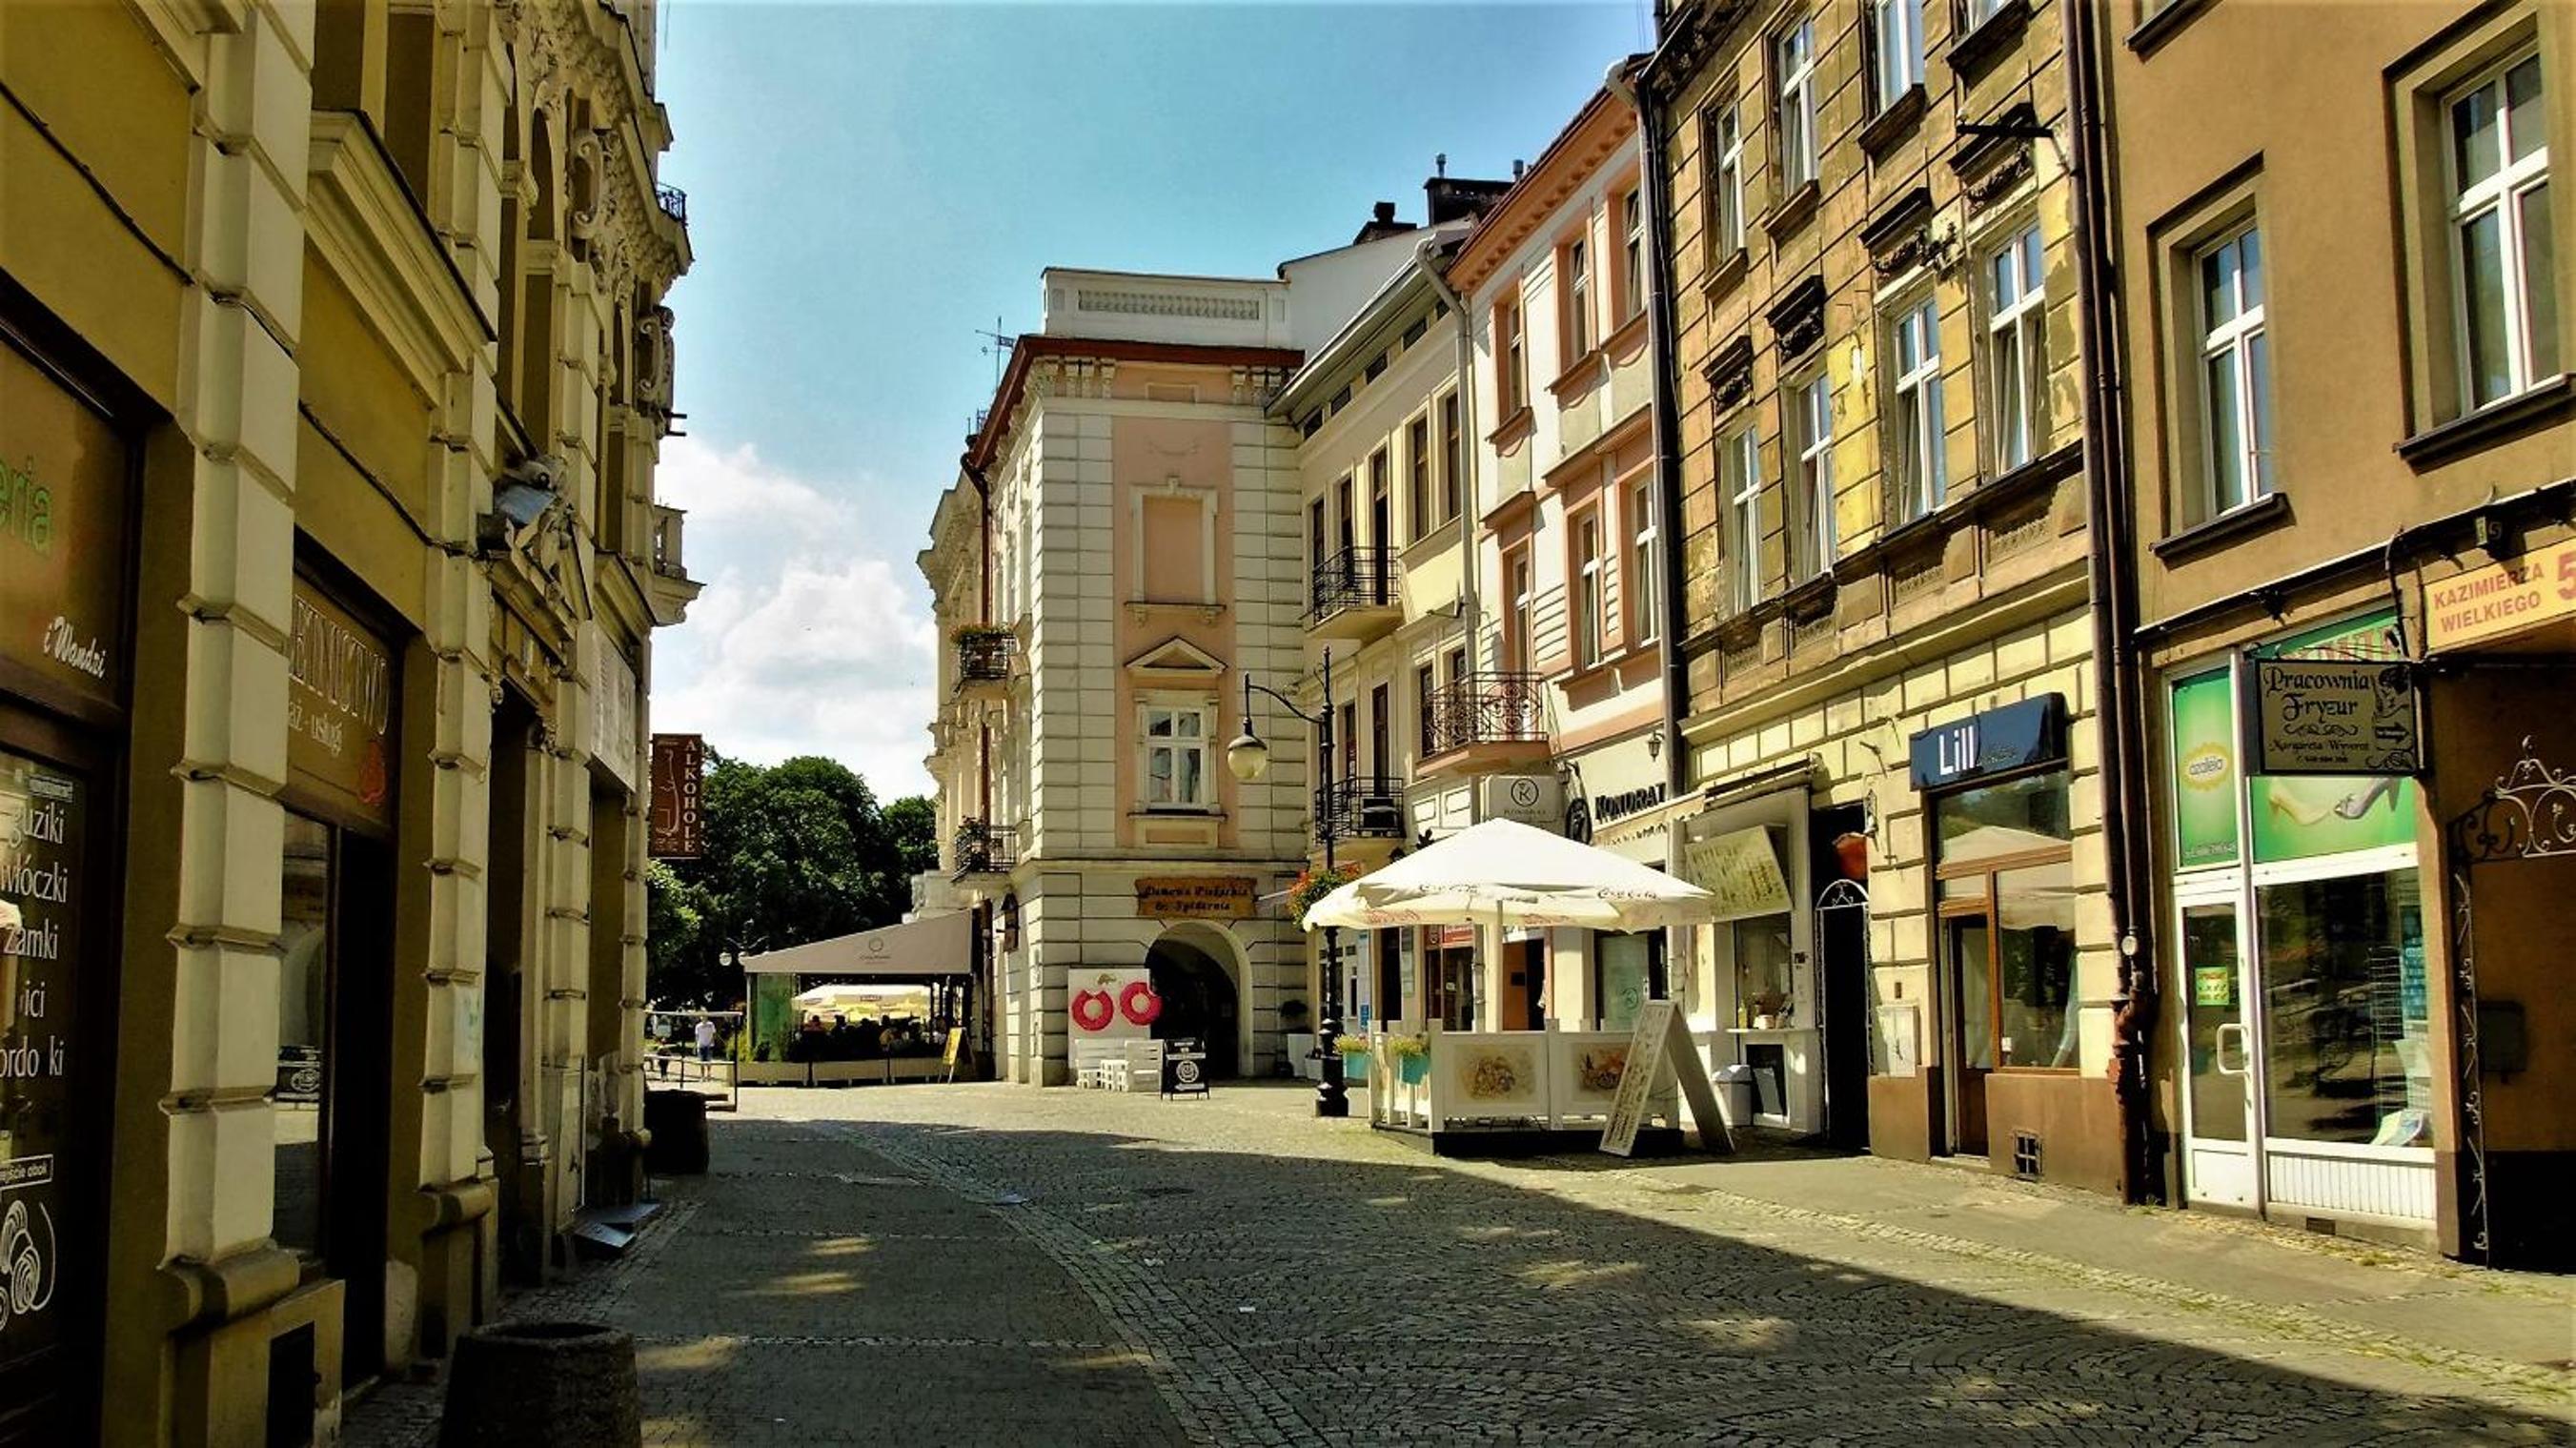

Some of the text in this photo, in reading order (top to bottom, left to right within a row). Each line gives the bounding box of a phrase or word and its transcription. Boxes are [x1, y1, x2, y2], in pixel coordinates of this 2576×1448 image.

[2433, 550, 2576, 610] KAZIMIERZA 5
[2441, 590, 2543, 633] WIELKIEGO
[2262, 665, 2370, 698] Pracownia
[2281, 692, 2359, 724] Fryzur
[682, 738, 698, 853] ALKOHOLE
[1594, 782, 1667, 825] KONDRAT
[9, 801, 65, 848] guziki
[0, 854, 69, 904] włóczki
[4, 918, 58, 960] zamki
